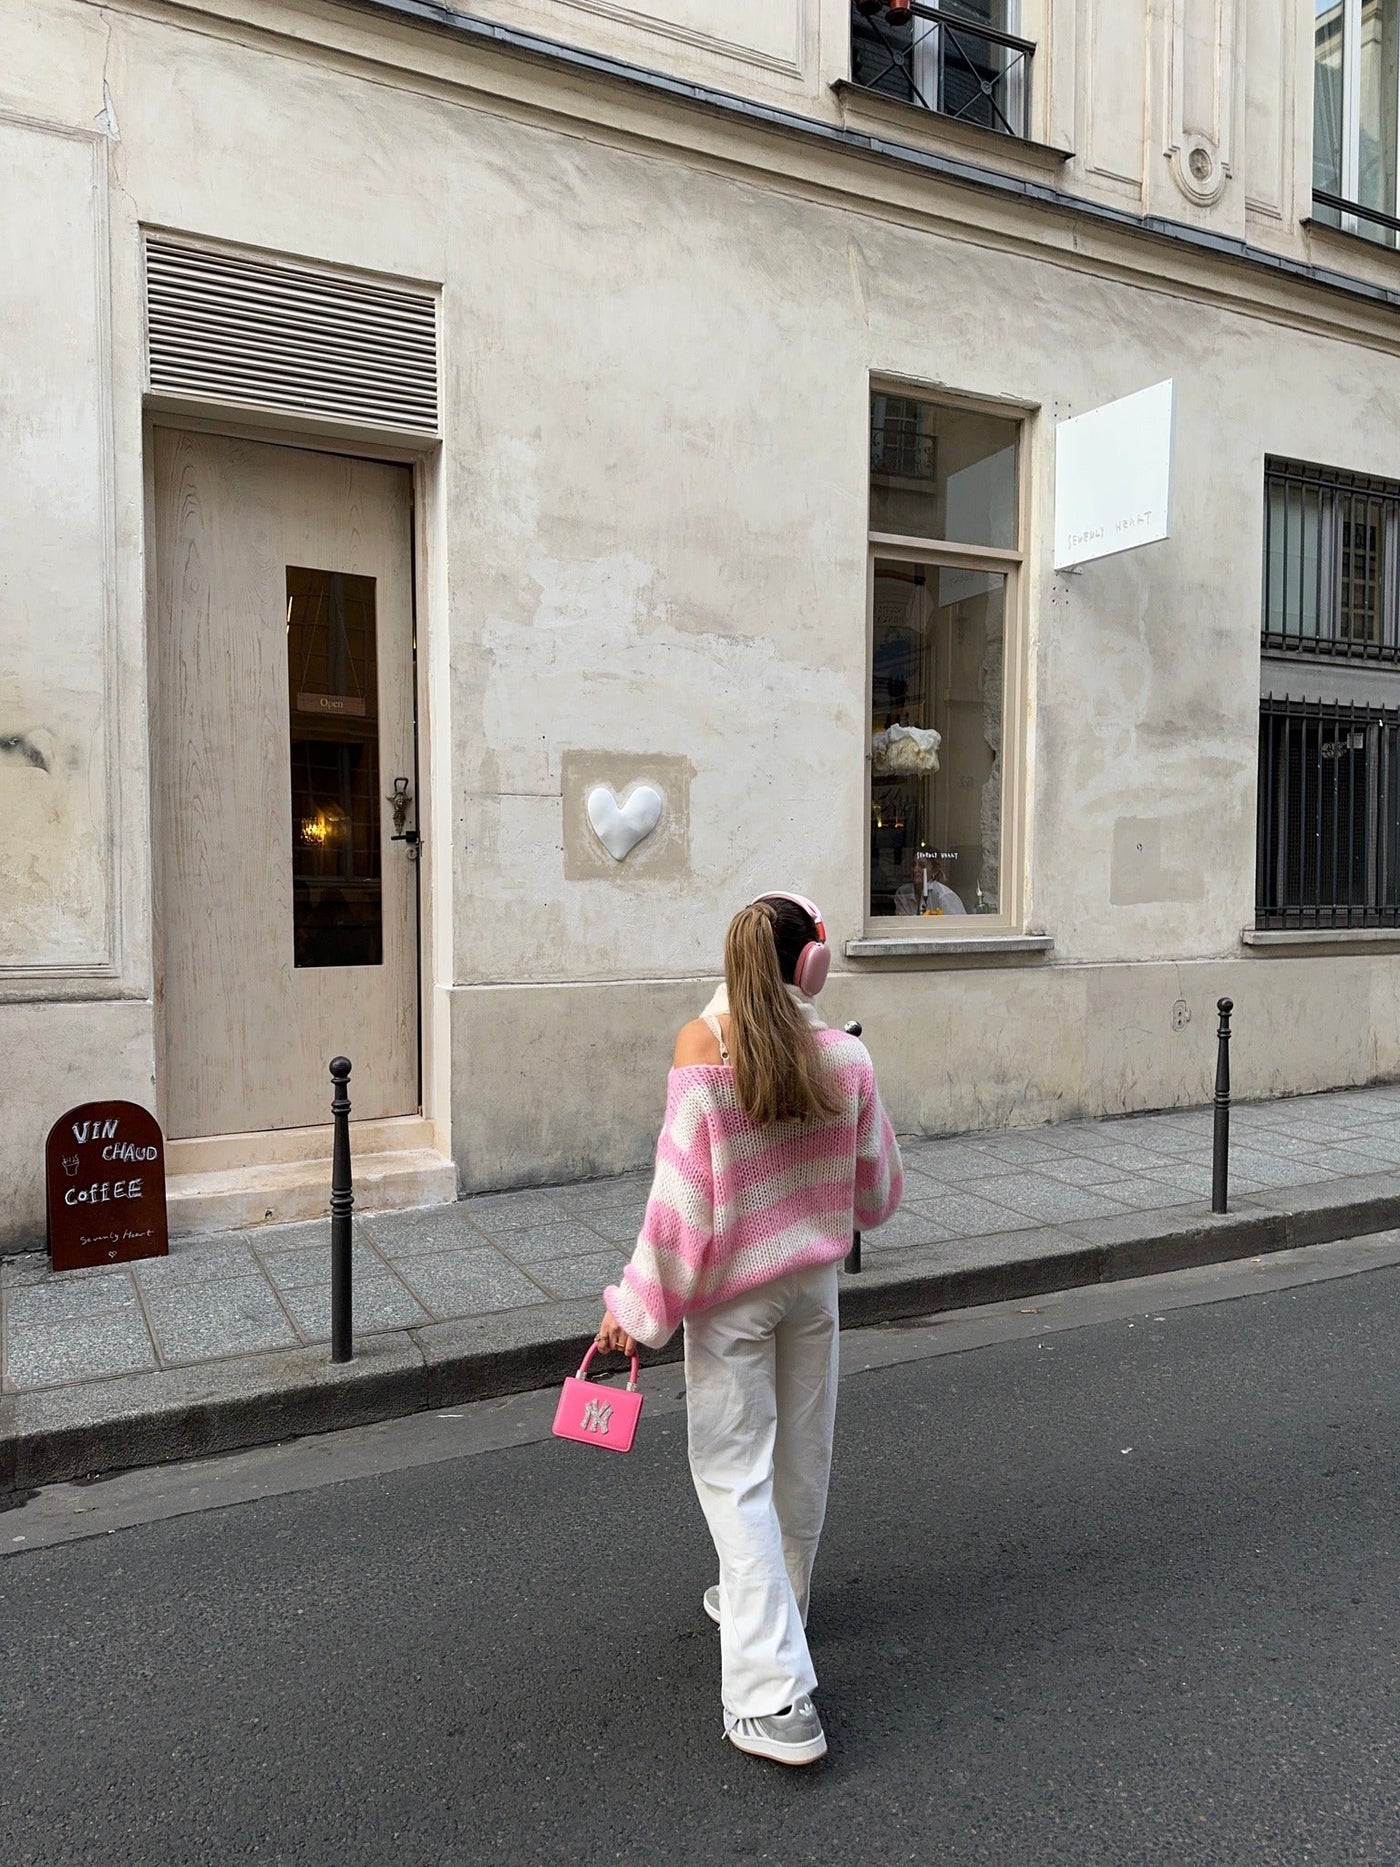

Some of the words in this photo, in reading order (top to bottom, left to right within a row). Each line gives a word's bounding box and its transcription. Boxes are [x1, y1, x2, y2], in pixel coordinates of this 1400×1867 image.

[1115, 511, 1152, 533] HEART
[320, 697, 344, 710] Open
[72, 1119, 118, 1144] VIN
[102, 1142, 158, 1162] CHAUD
[122, 1229, 156, 1240] Heart
[581, 1398, 614, 1435] NY
